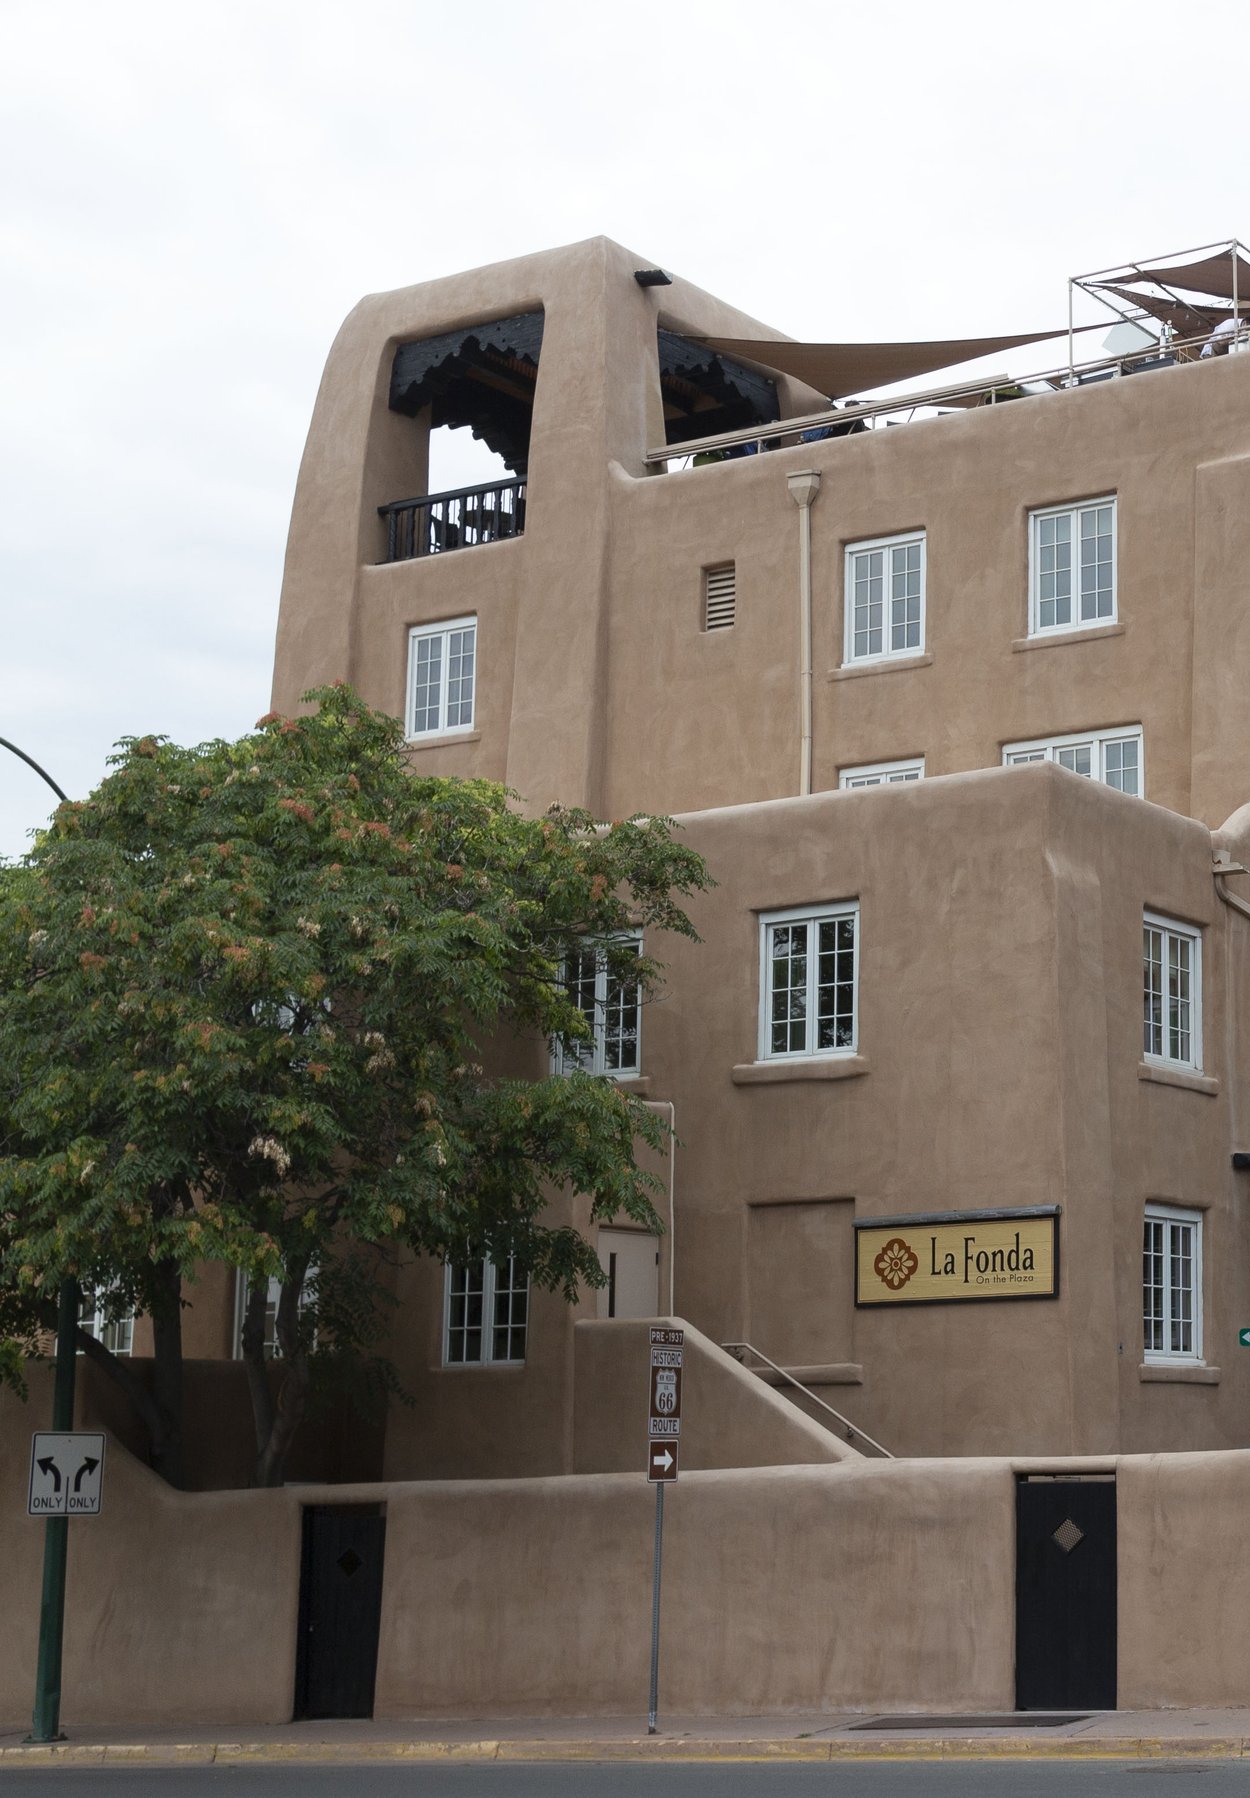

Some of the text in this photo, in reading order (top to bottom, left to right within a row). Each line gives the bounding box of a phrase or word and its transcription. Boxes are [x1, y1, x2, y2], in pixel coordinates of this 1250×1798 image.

[930, 1232, 1035, 1283] La Fonda
[976, 1273, 1034, 1285] On the Plaza
[653, 1352, 681, 1365] HISTORIC
[659, 1392, 673, 1409] 66
[652, 1419, 678, 1432] ROUTE
[33, 1497, 62, 1508] ONLY
[69, 1497, 97, 1508] ONLY
